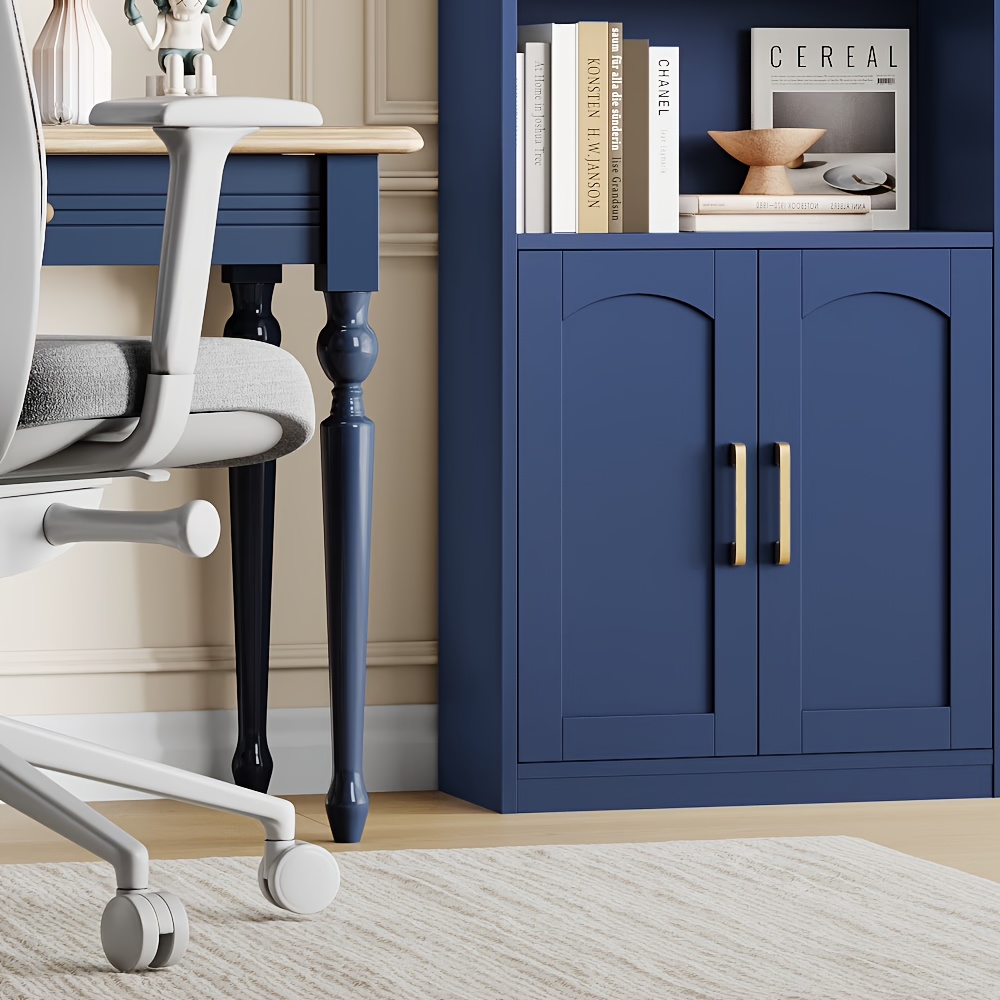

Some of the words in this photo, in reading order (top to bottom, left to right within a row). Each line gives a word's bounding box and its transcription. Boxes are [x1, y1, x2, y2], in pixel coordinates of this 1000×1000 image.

[534, 60, 545, 71] At
[611, 54, 622, 69] für
[770, 45, 898, 68] CEREAL
[534, 74, 545, 100] Home
[587, 57, 601, 118] KONSTEN
[611, 71, 622, 89] alla
[658, 58, 671, 116] CHANEL
[534, 103, 545, 112] in
[611, 91, 622, 107] die
[531, 113, 546, 144] Joshua
[611, 108, 622, 151] sünderin
[534, 147, 545, 166] Tree
[611, 156, 622, 173] lise
[611, 176, 622, 221] Grandsun
